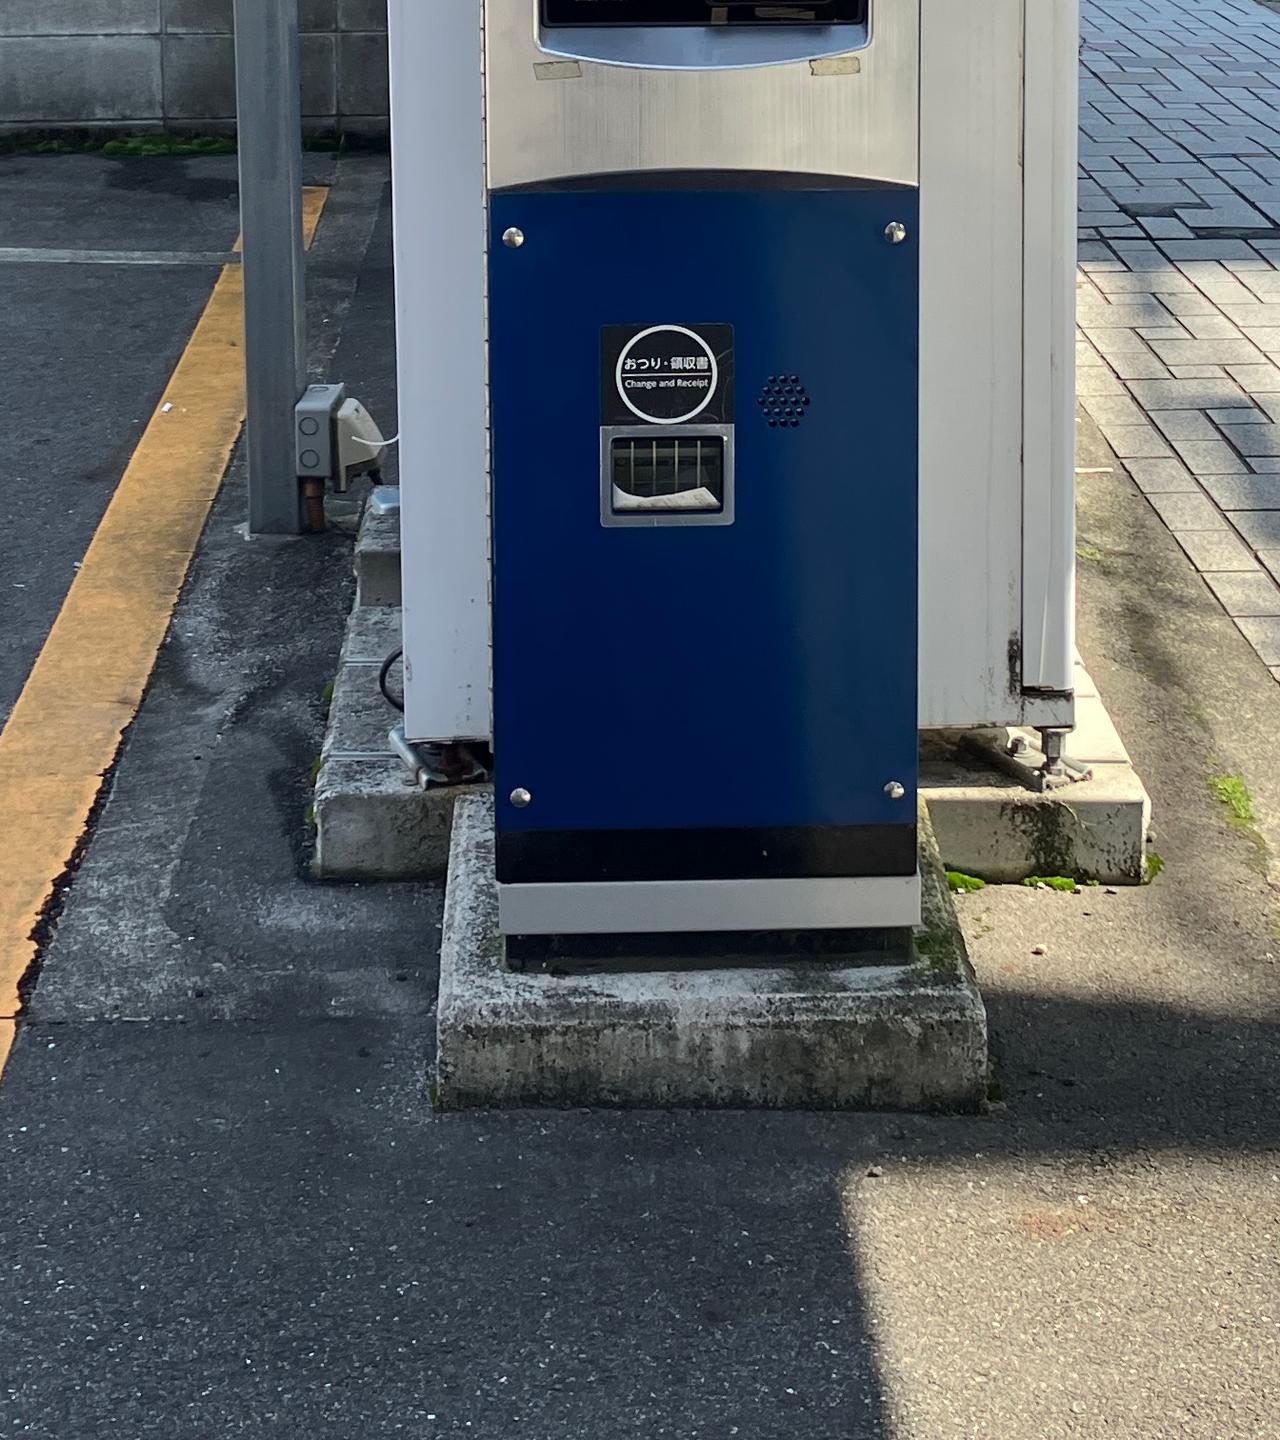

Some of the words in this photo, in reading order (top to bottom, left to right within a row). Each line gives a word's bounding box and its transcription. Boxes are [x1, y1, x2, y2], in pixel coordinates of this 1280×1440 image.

[624, 356, 709, 371] おつり・領収書
[625, 378, 657, 389] Change
[659, 378, 675, 387] and
[676, 378, 709, 389] Receipt
